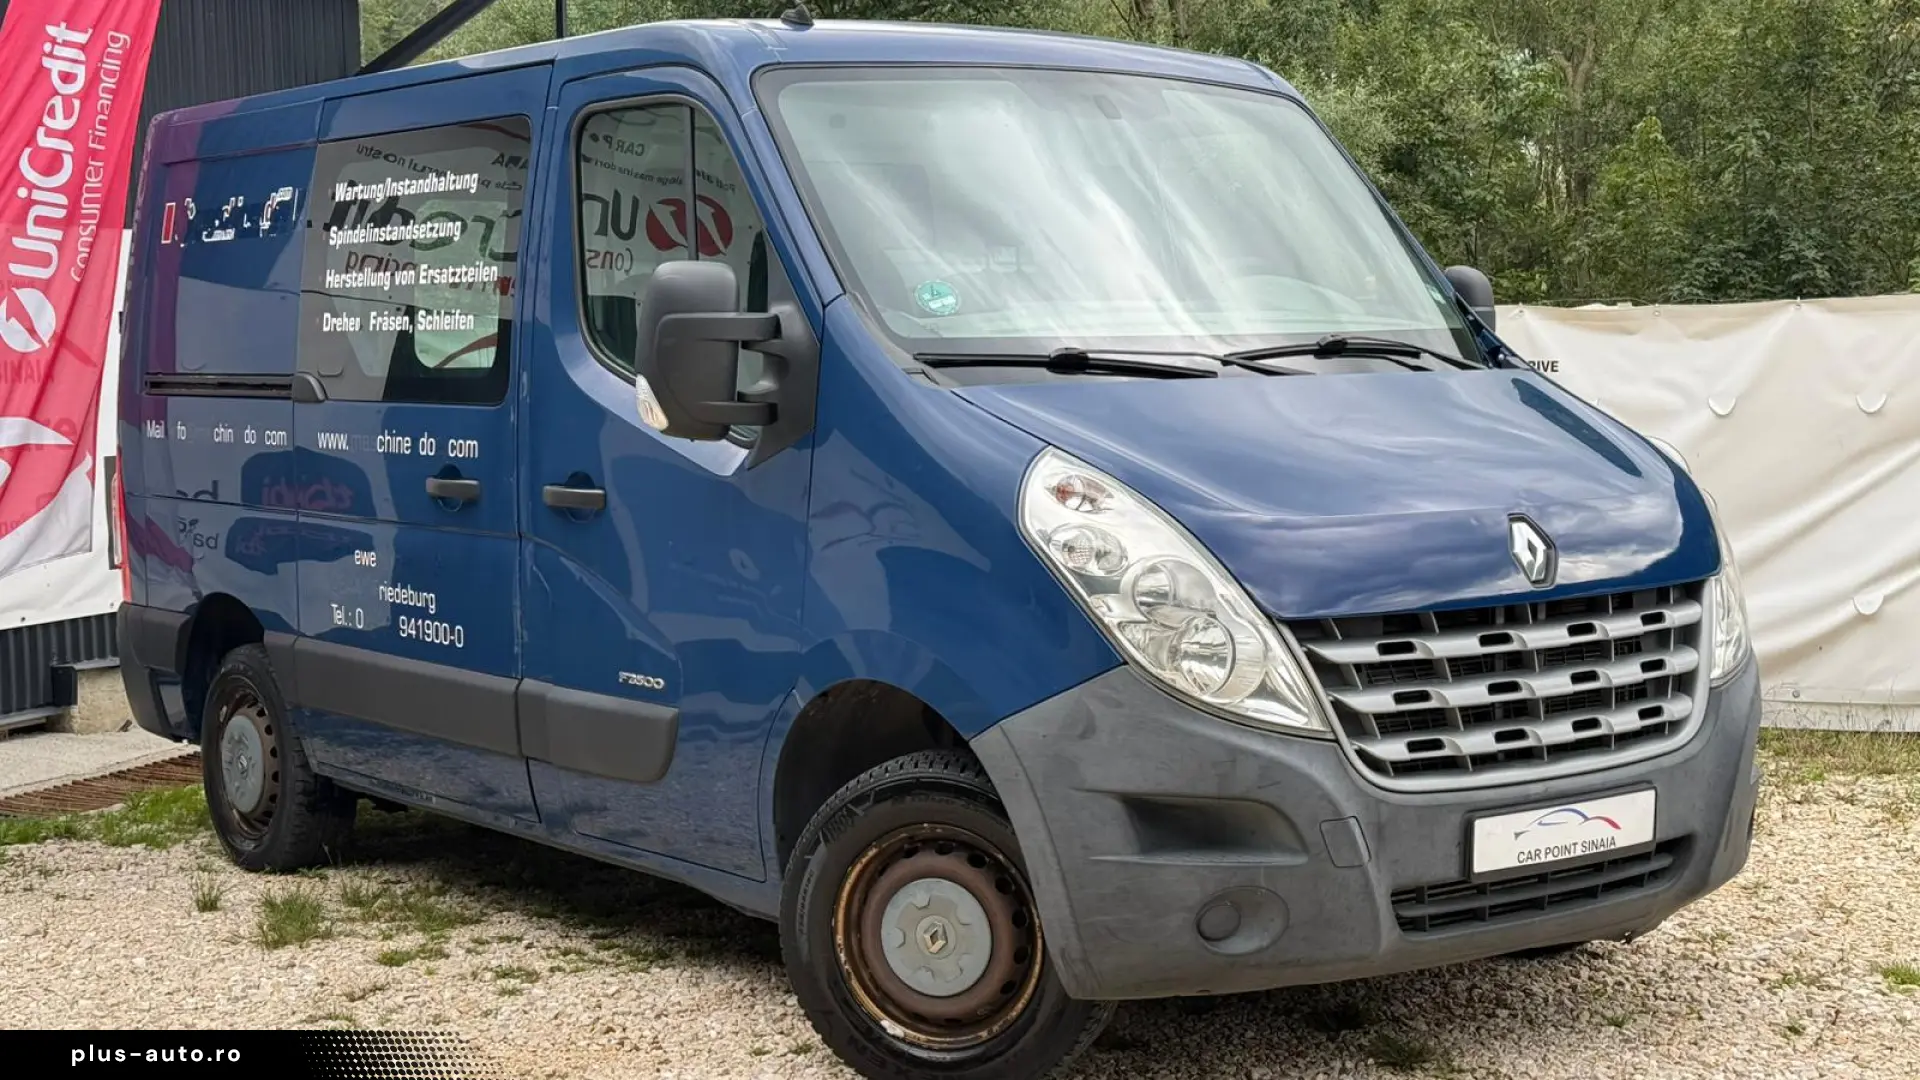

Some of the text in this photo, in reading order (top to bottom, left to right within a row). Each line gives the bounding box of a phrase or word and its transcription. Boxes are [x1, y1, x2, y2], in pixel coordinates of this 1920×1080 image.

[9, 21, 93, 280] UniCredit
[70, 30, 131, 283] Consumer Financing
[335, 171, 479, 202] Wartung/Instandhaltung
[328, 219, 462, 249] Spindelinstandsetzung
[325, 261, 498, 291] Herstellung von Ersatzteilen
[417, 308, 474, 331] Schleifen
[244, 425, 257, 445] do
[264, 429, 287, 446] com
[419, 432, 436, 456] do
[448, 438, 479, 459] com
[354, 549, 377, 568] ewe
[378, 580, 436, 615] riedeburg
[399, 616, 464, 648] 941900-0
[1516, 836, 1617, 865] CAR POINT SINAIA
